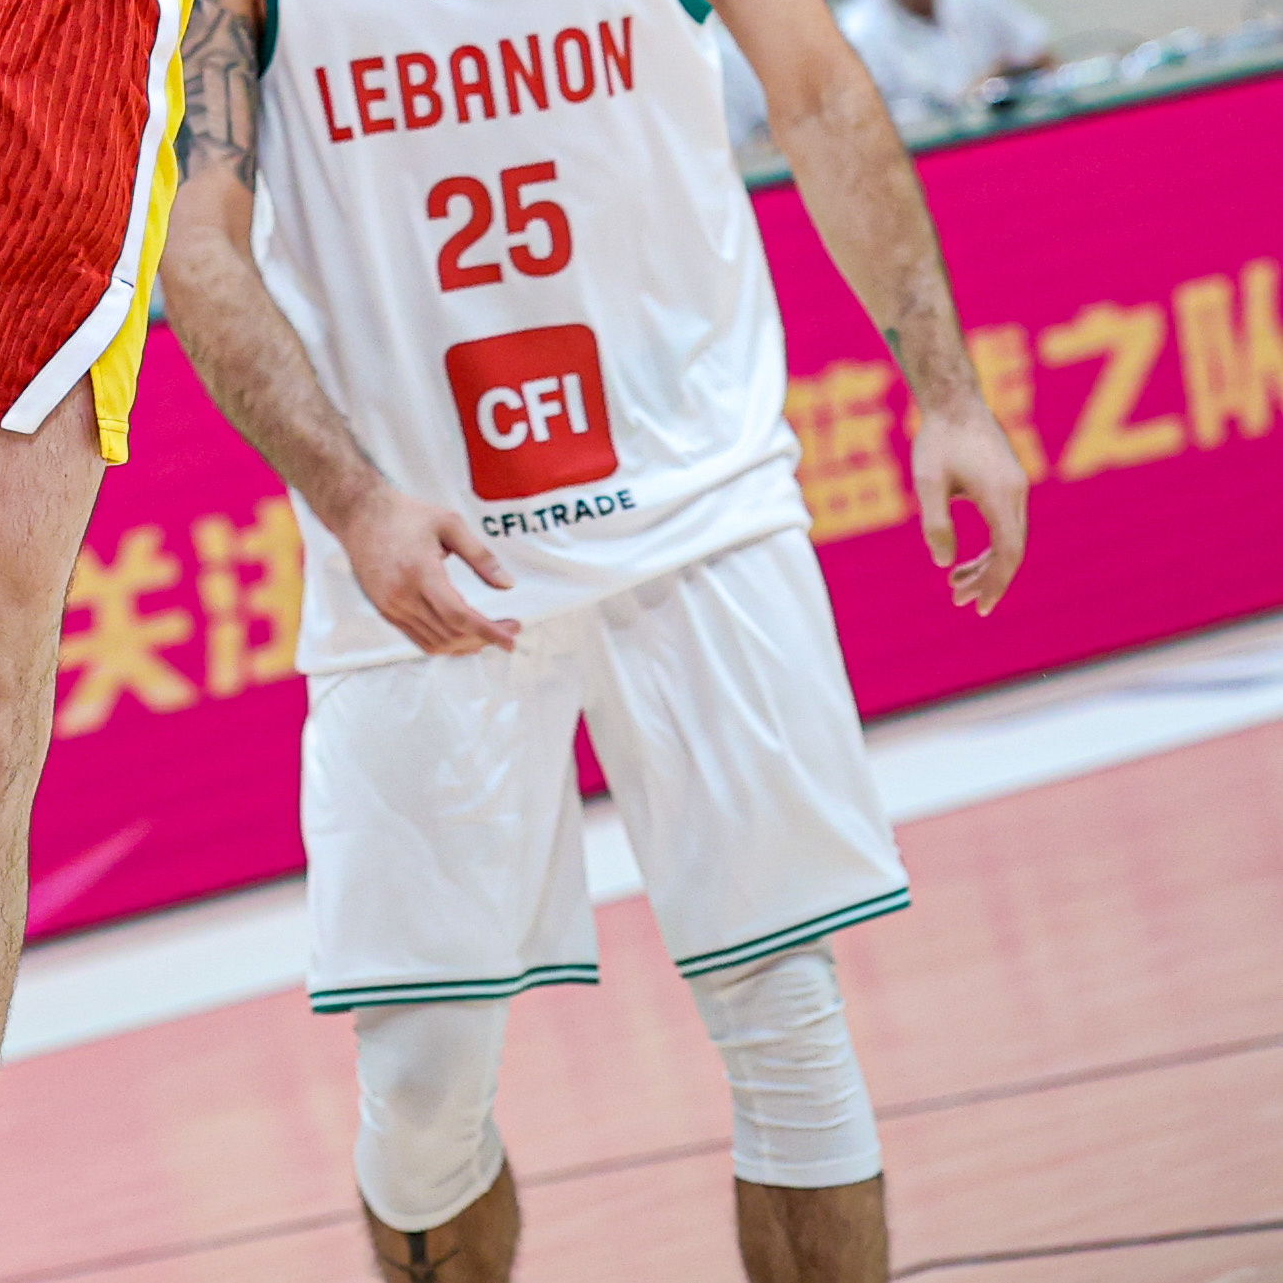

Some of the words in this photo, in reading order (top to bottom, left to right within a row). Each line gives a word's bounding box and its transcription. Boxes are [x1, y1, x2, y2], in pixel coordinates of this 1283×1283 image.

[315, 15, 634, 143] LEBANON
[426, 161, 573, 292] 25
[476, 372, 589, 450] CFI
[482, 489, 637, 537] CFI.TRADE
